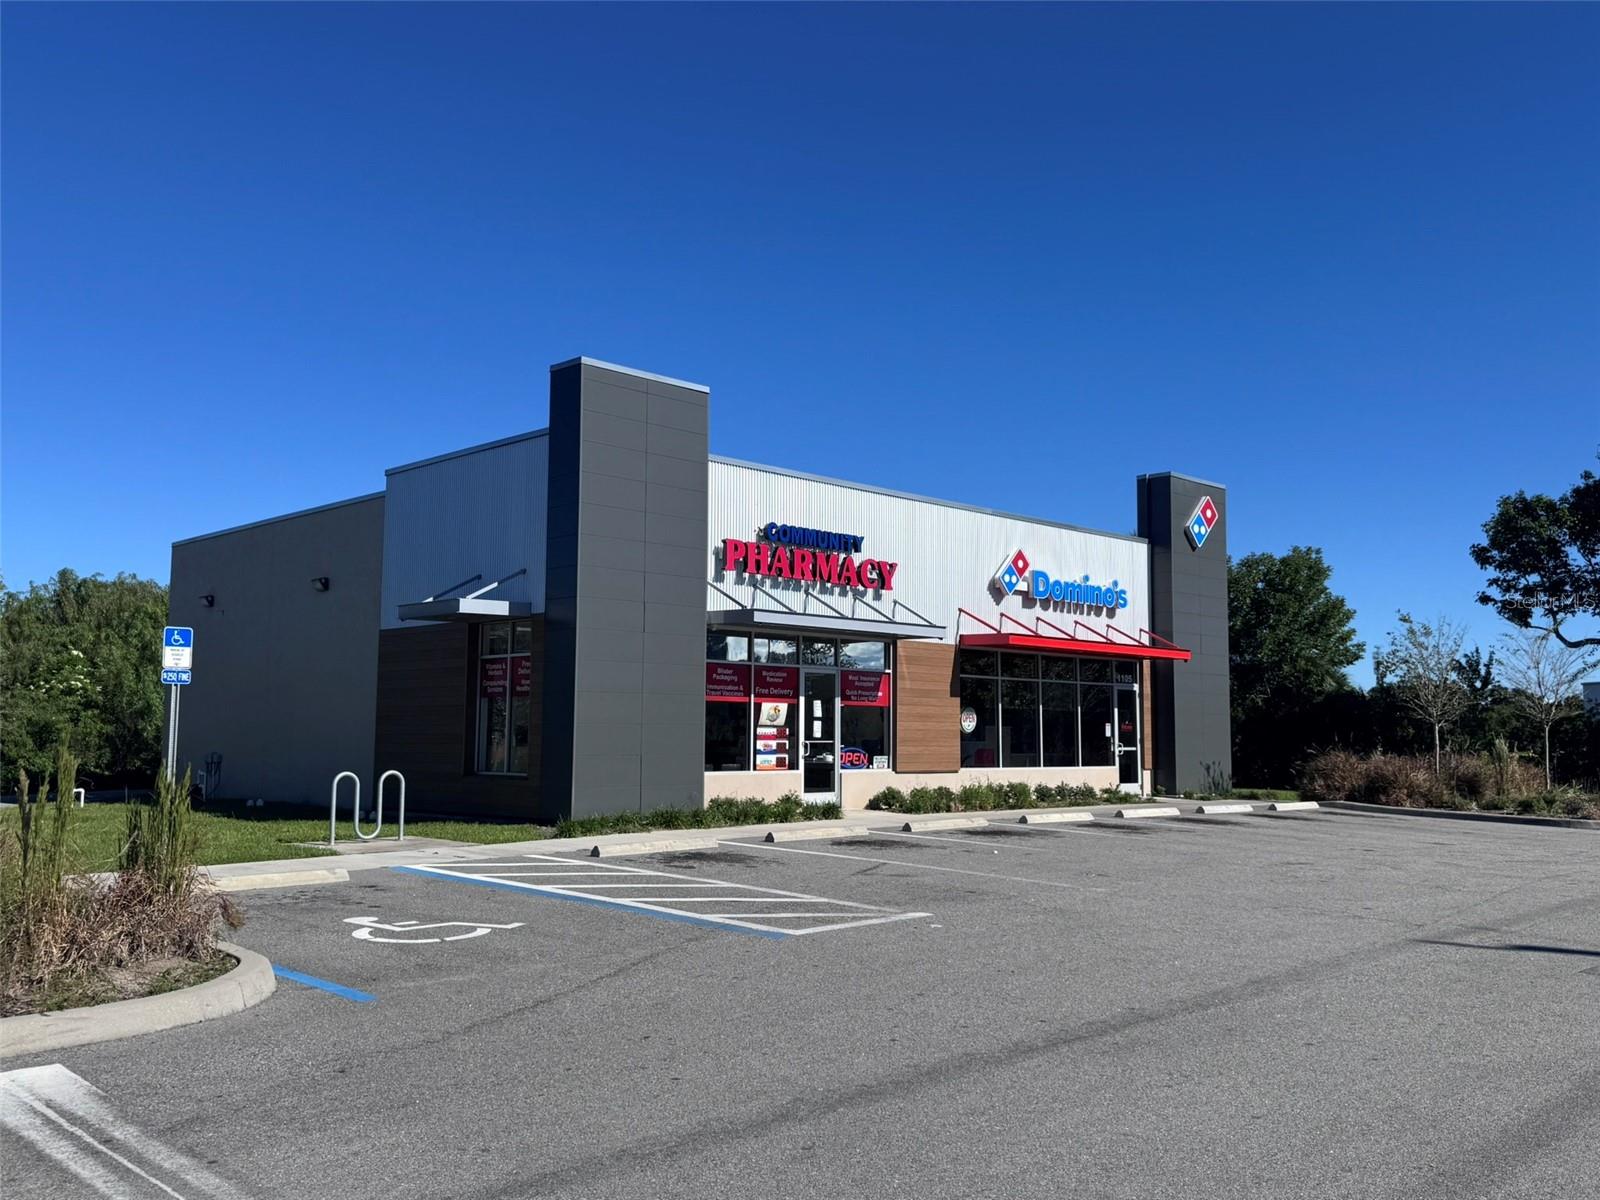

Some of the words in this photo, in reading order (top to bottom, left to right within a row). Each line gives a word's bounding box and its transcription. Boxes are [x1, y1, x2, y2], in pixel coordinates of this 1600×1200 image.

[766, 522, 865, 553] COMMUNITY
[722, 538, 898, 591] PHARMACY
[1032, 569, 1128, 609] Domino's
[178, 672, 189, 681] FINE
[712, 674, 738, 682] Packaging
[755, 686, 769, 695] Free
[769, 688, 793, 697] Delivery
[962, 712, 976, 723] OPEN
